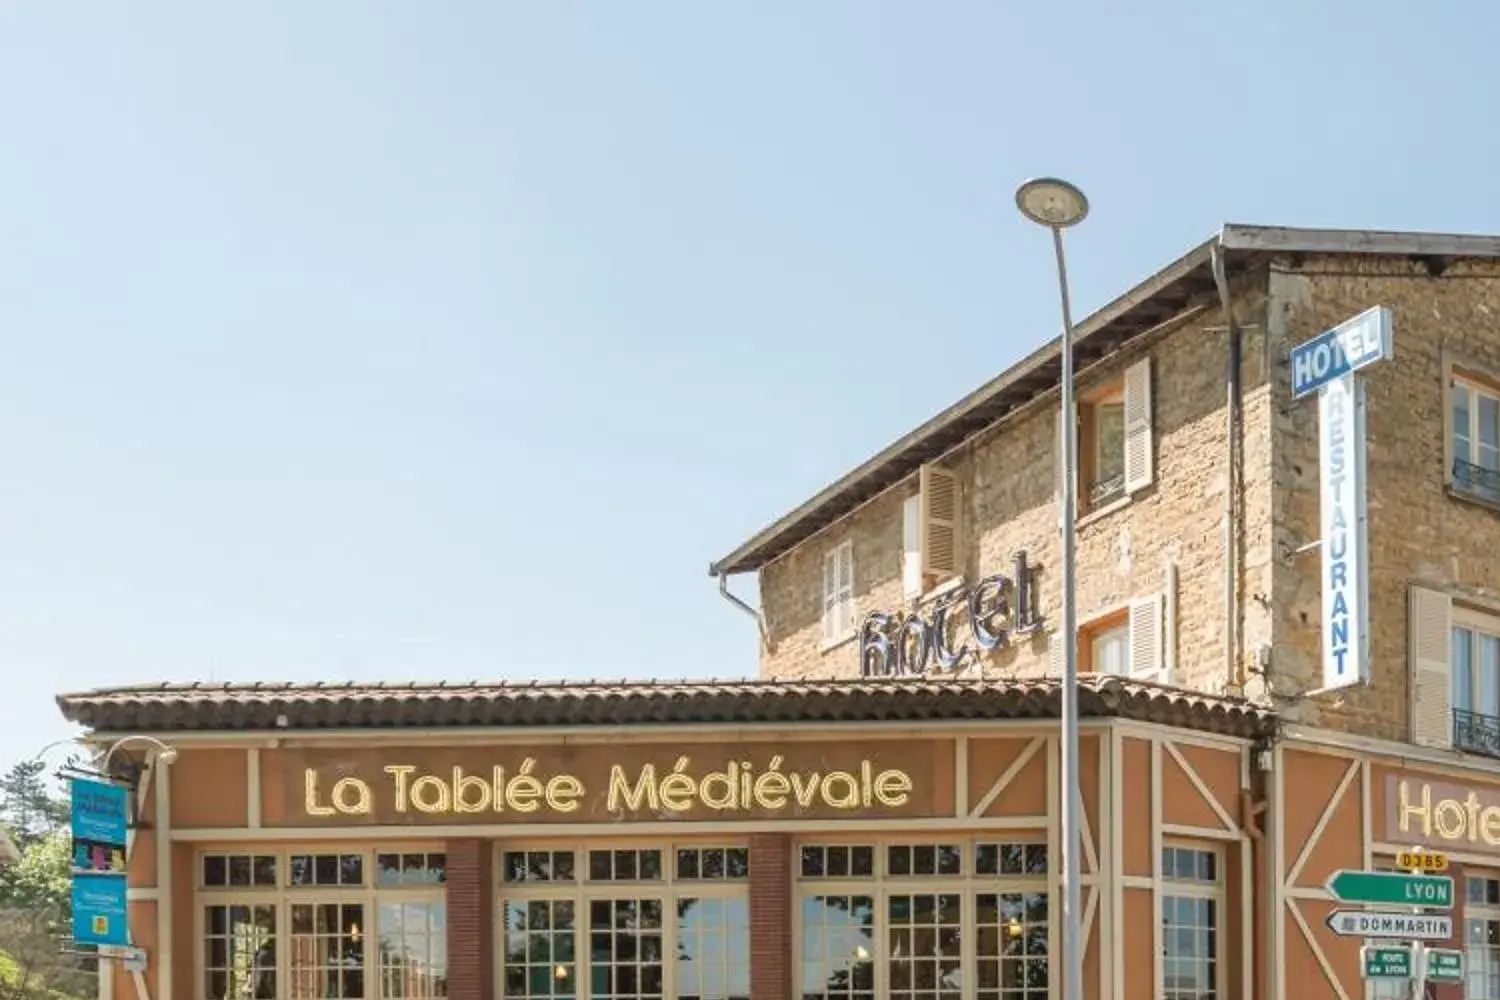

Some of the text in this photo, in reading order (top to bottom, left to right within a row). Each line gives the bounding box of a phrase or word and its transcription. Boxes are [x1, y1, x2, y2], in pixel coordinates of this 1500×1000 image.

[1295, 321, 1379, 388] HOTEL
[1327, 390, 1349, 676] RESTAURANT
[305, 755, 914, 816] La Tablée Médiévale
[1405, 882, 1448, 900] LYON
[1360, 917, 1448, 934] DOMMARTIN
